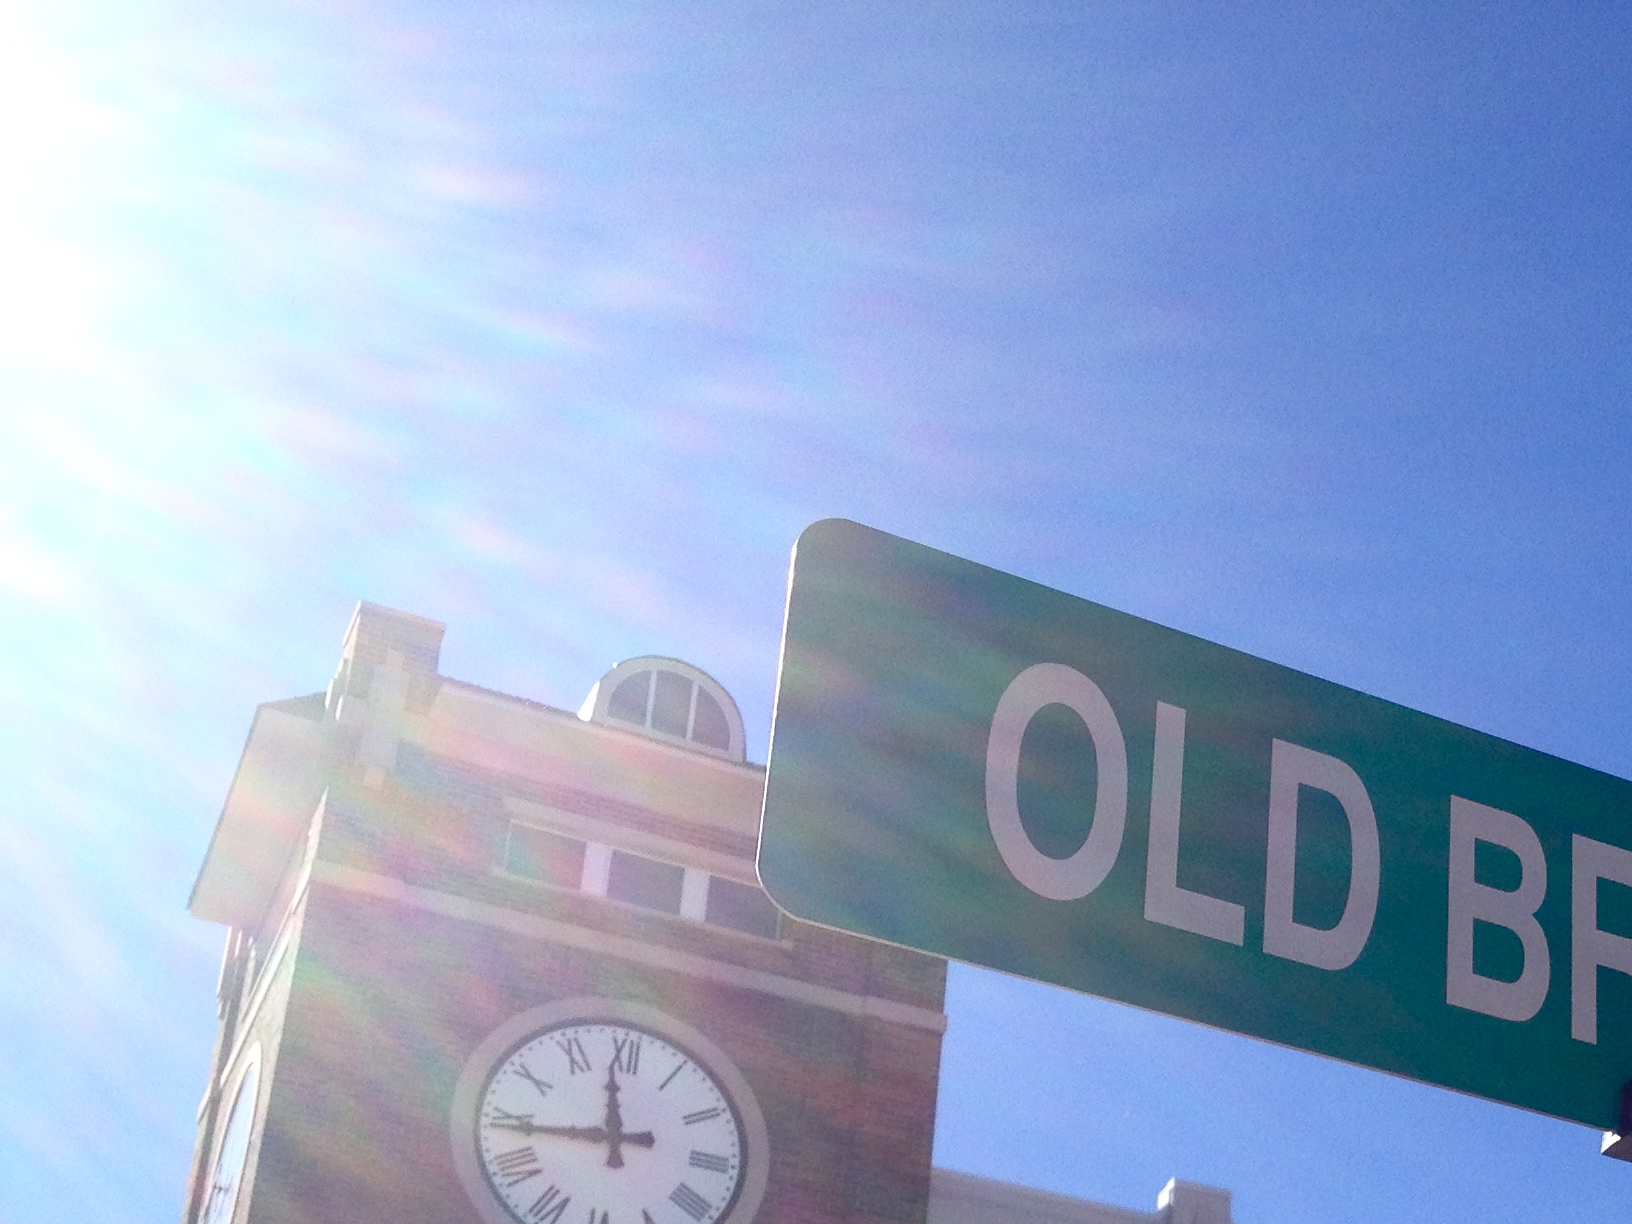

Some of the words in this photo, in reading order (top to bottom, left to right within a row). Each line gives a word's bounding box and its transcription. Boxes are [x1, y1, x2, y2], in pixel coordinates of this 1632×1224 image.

[982, 661, 1381, 971] OLD
[555, 1037, 592, 1075] XI
[512, 1062, 554, 1097] X
